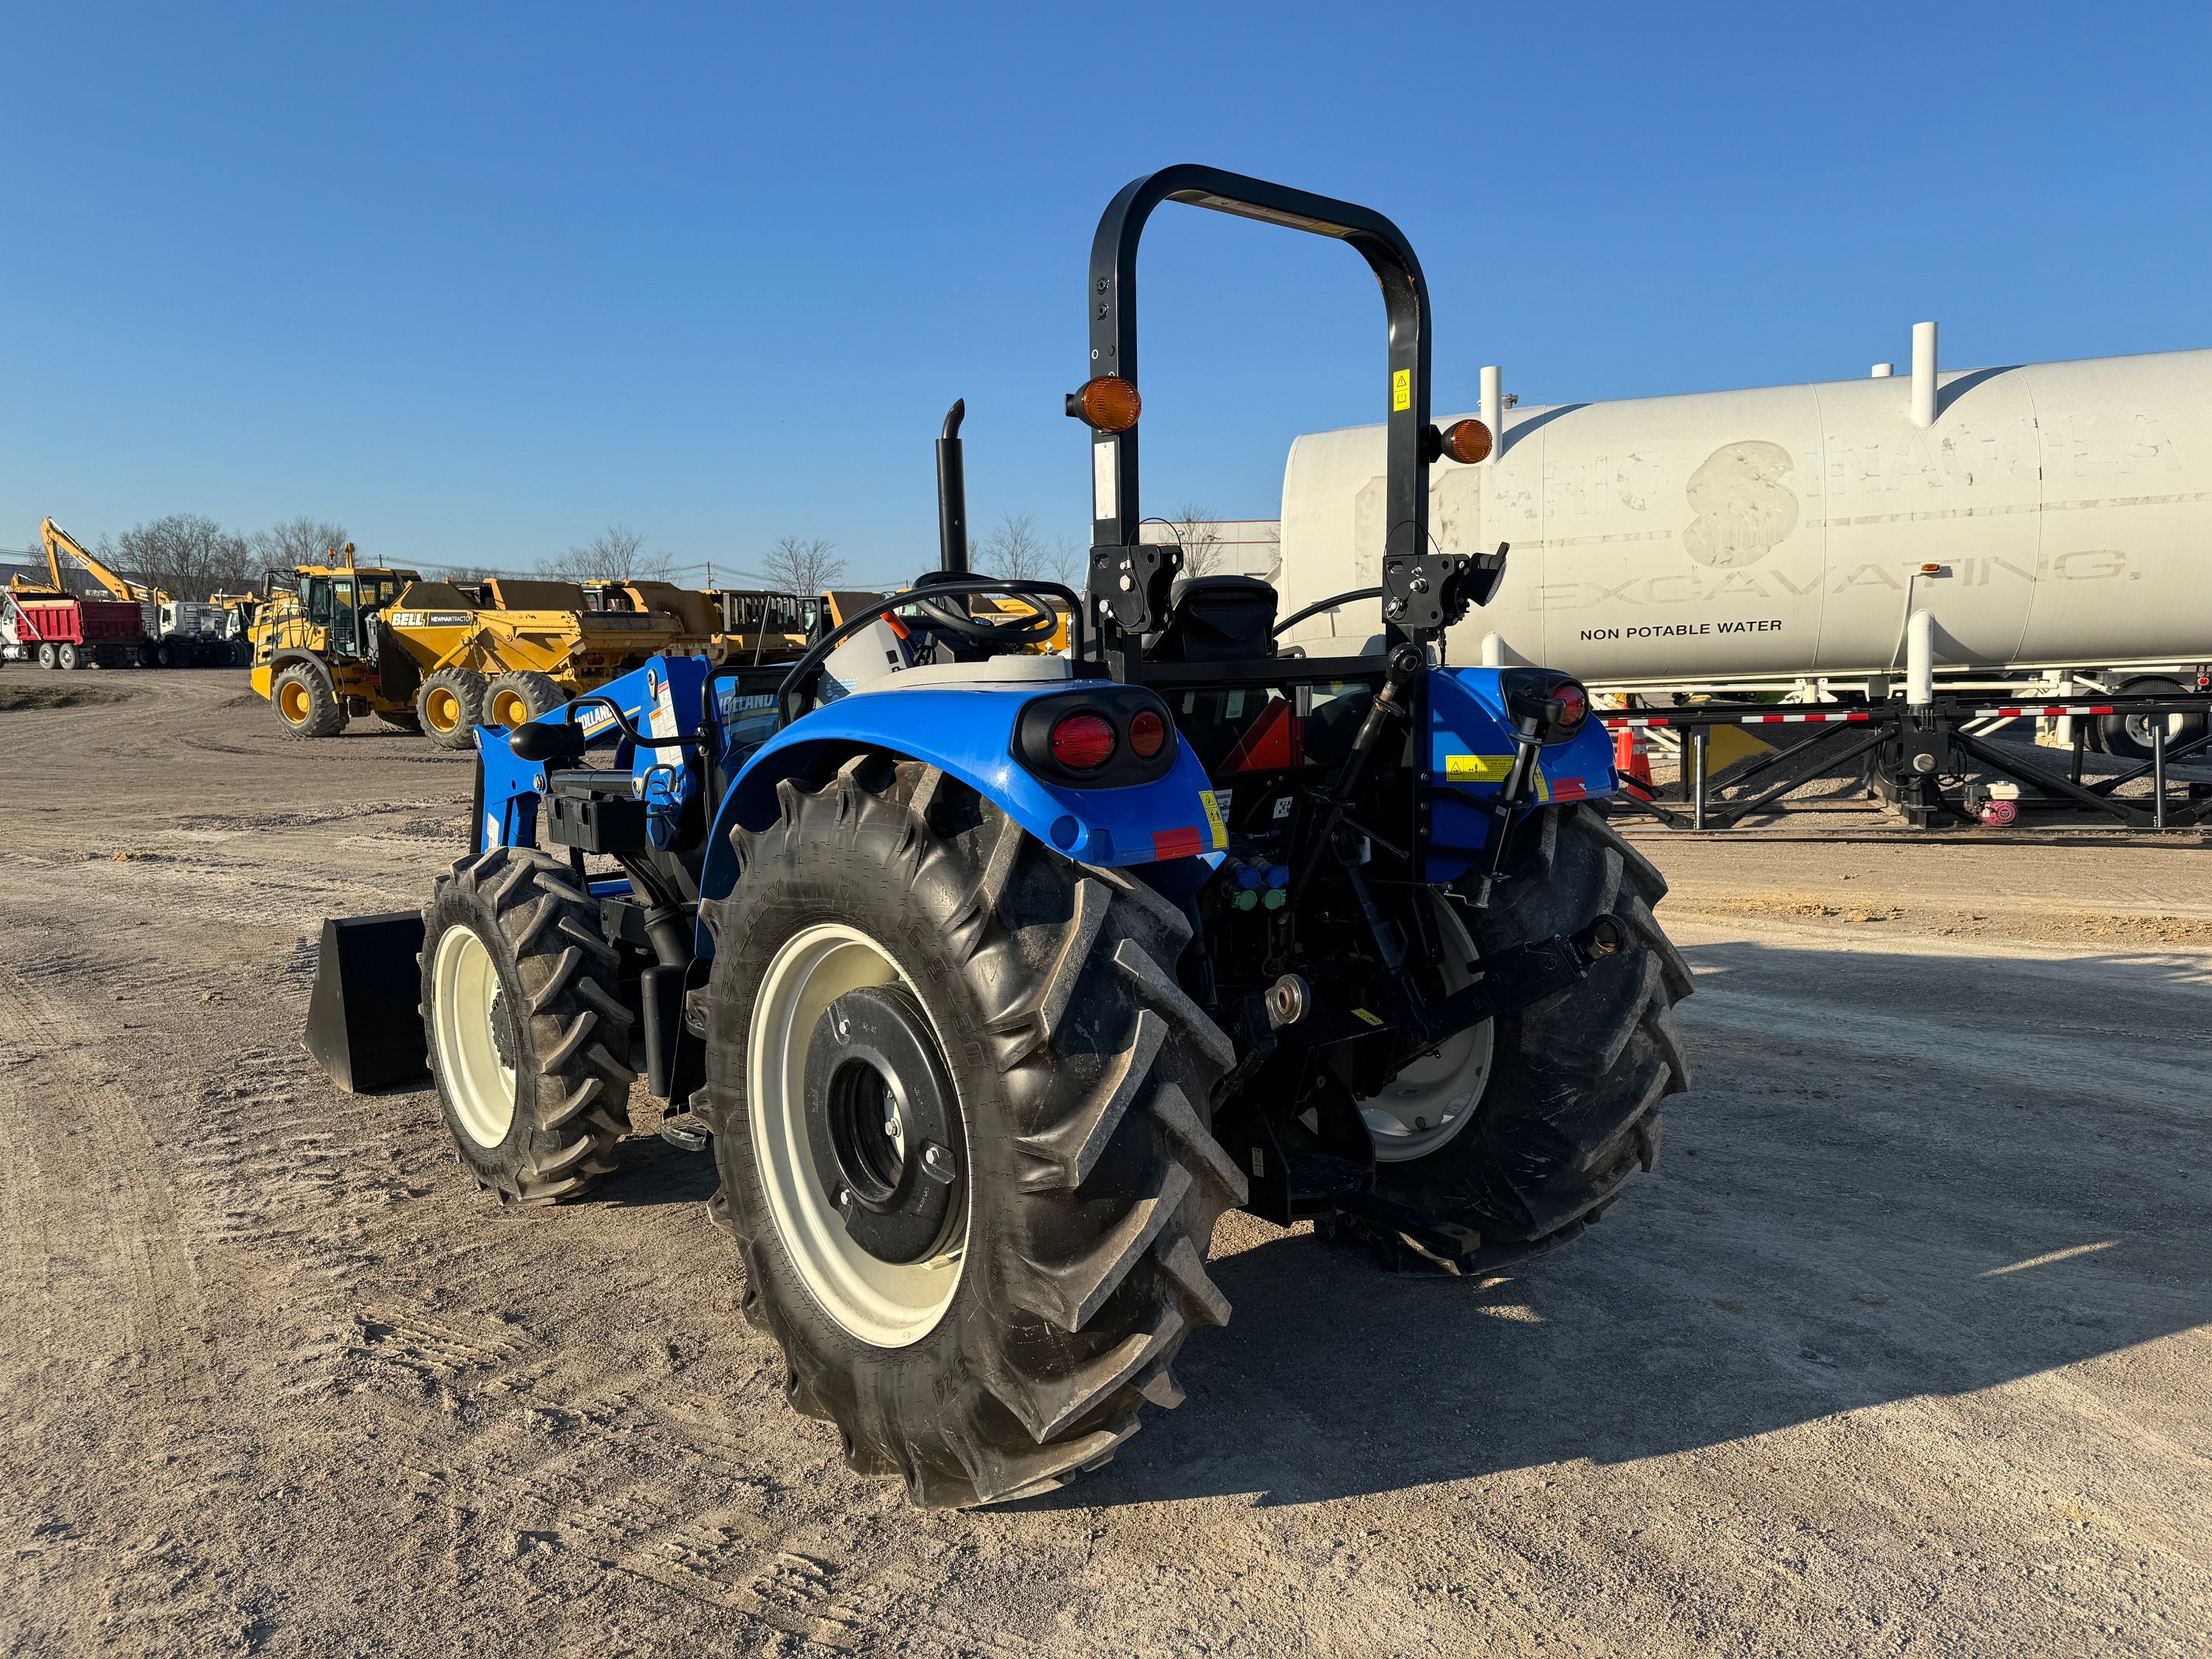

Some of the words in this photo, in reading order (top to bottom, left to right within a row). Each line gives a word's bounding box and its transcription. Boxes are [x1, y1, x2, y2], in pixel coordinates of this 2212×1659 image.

[391, 613, 423, 627] BELL
[1581, 628, 1620, 641] NON
[1626, 623, 1711, 638] POTABLE
[1717, 620, 1782, 634] WATER
